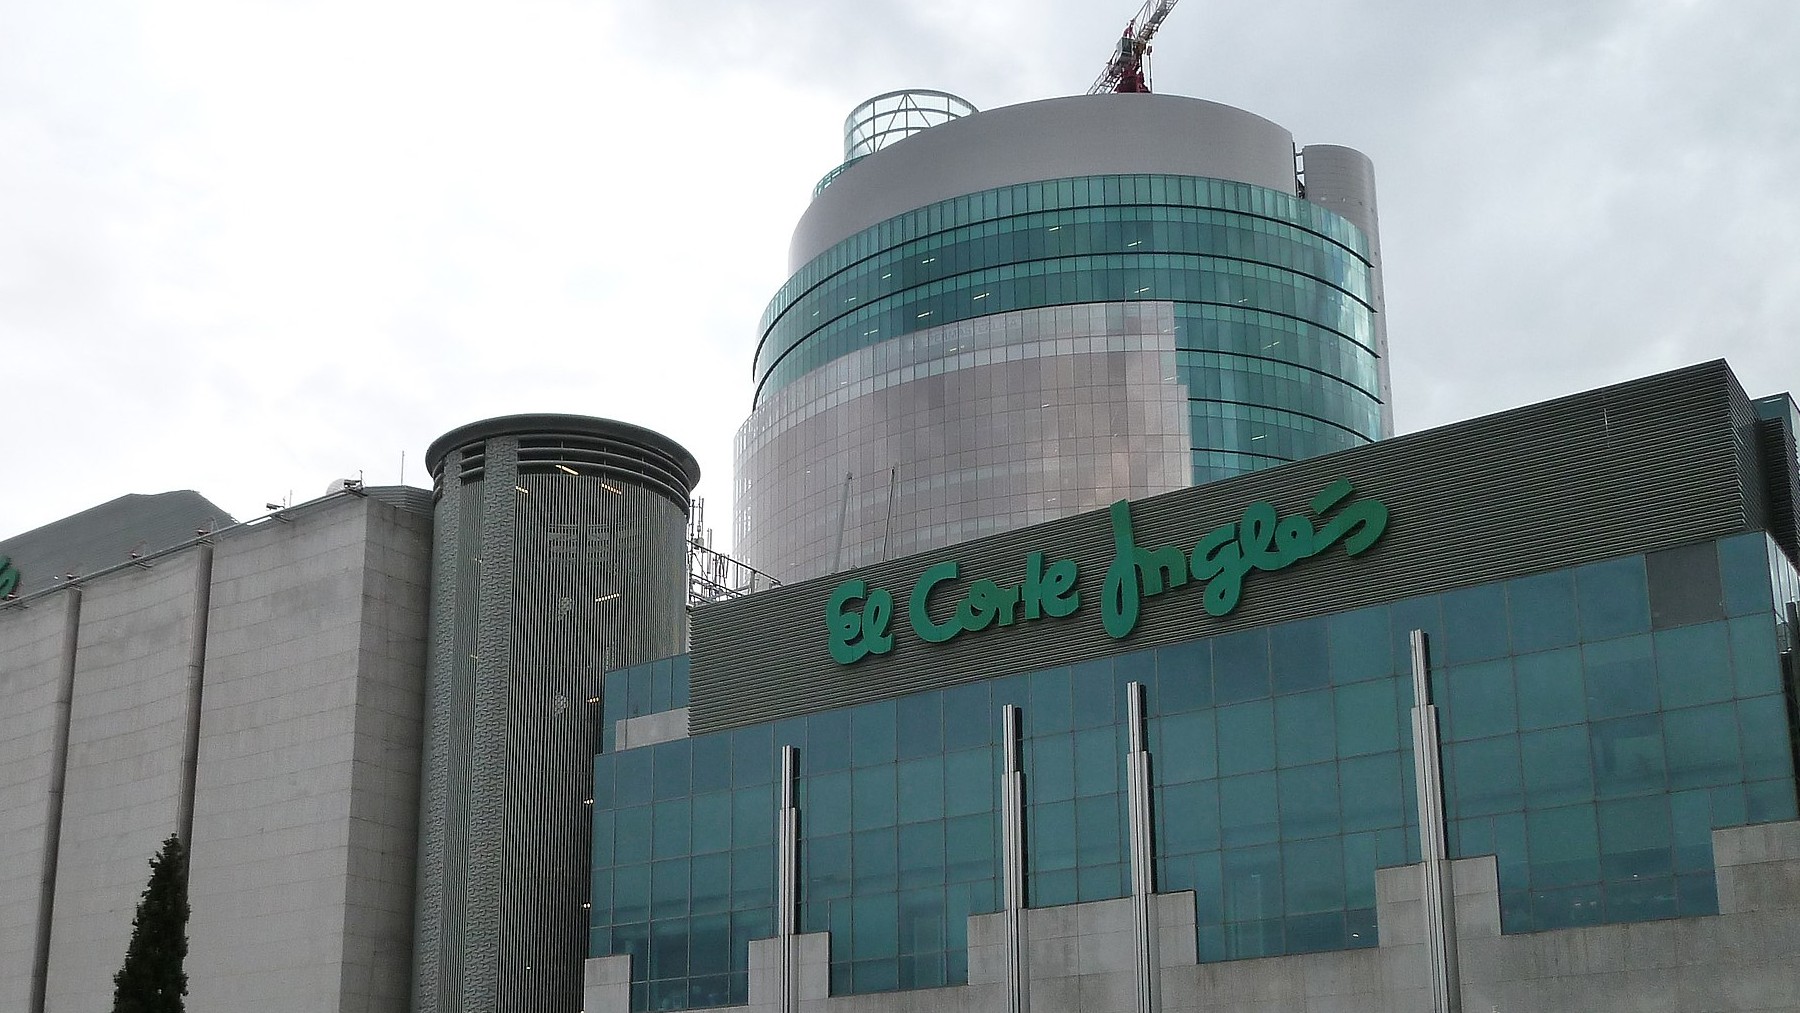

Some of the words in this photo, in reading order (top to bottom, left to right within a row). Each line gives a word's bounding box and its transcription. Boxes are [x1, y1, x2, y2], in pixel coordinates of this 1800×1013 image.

[825, 579, 894, 664] El
[909, 551, 1079, 642] Corte
[1101, 479, 1389, 638] Inglés
